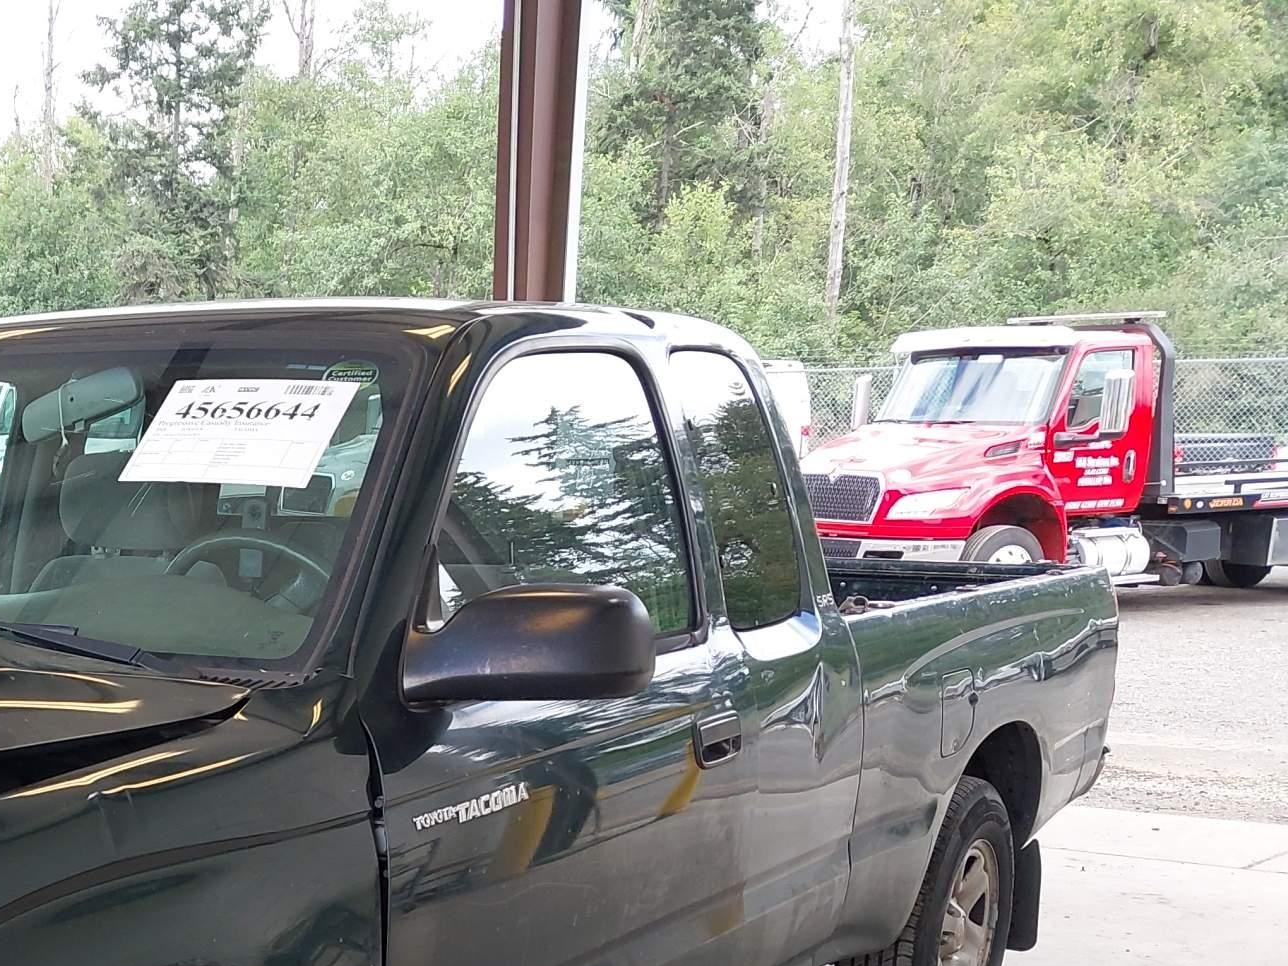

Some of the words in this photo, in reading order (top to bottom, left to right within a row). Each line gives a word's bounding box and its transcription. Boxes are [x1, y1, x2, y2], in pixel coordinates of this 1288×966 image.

[331, 369, 373, 377] Certified
[175, 400, 321, 420] 45656644
[412, 806, 458, 830] TOYOTA
[457, 782, 529, 823] TACOMA
